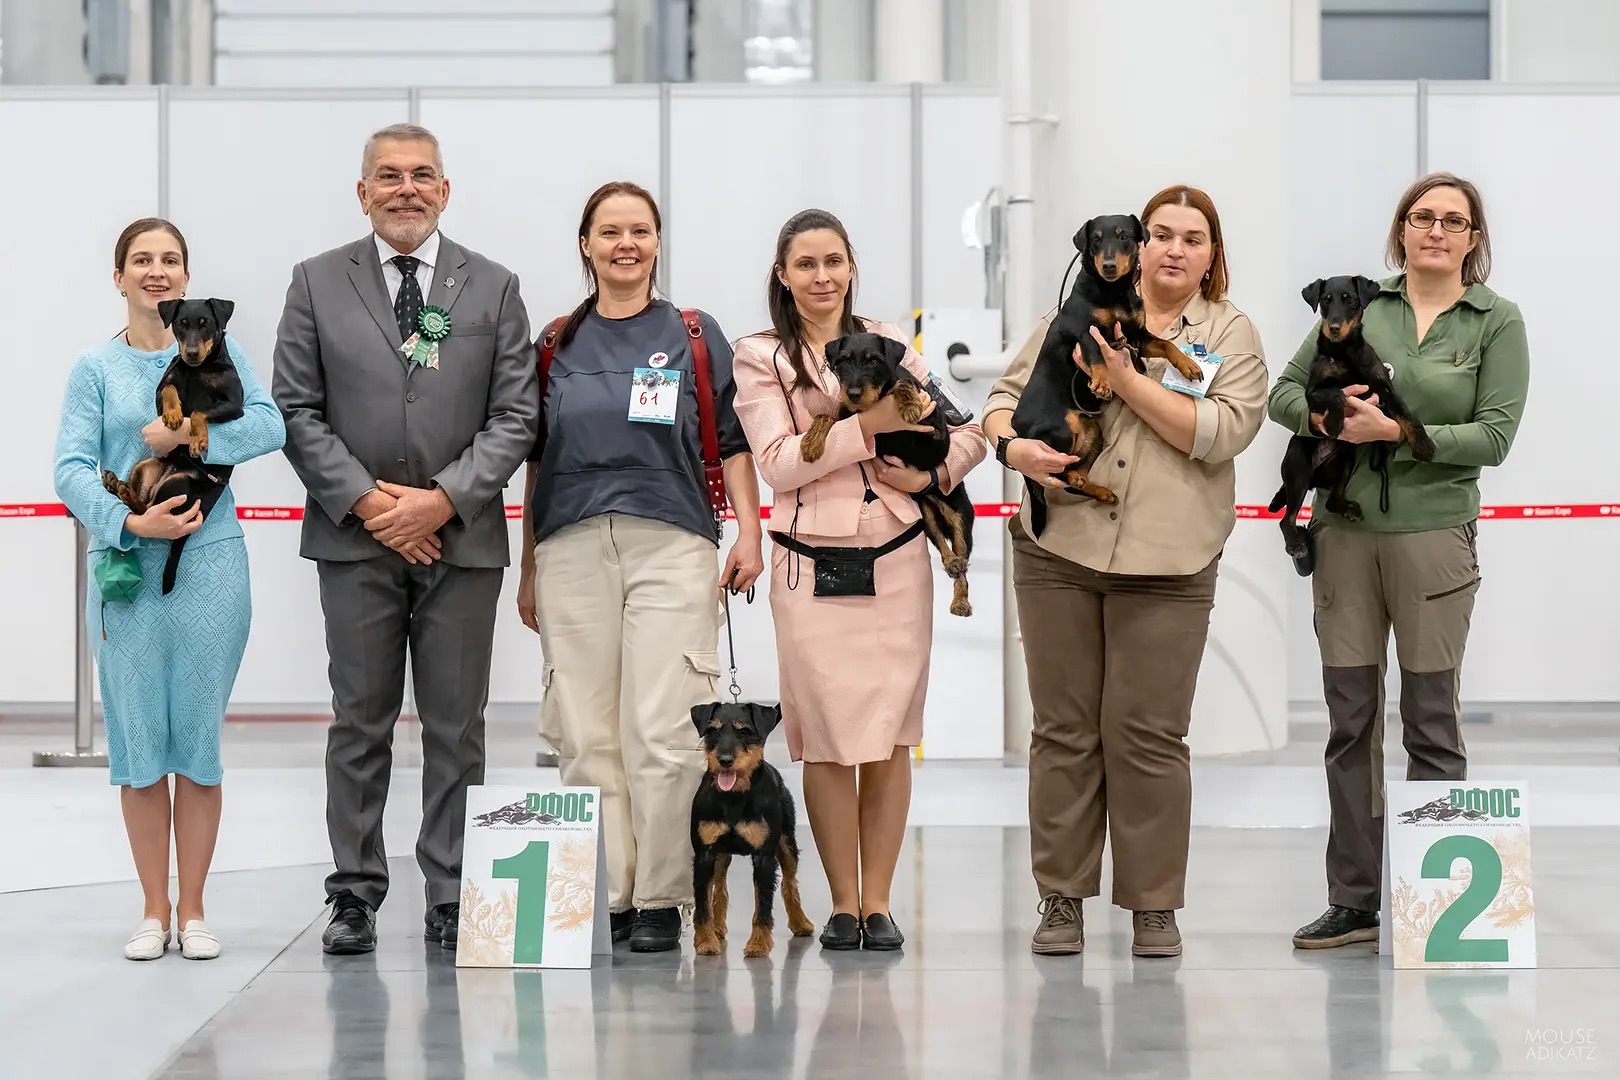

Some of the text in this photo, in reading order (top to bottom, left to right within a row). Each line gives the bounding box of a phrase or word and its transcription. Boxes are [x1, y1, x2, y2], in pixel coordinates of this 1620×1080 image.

[639, 391, 659, 406] 61
[525, 792, 594, 823] РФОС
[1449, 787, 1520, 818] РФОС
[491, 841, 549, 964] 1
[1420, 835, 1509, 962] 2
